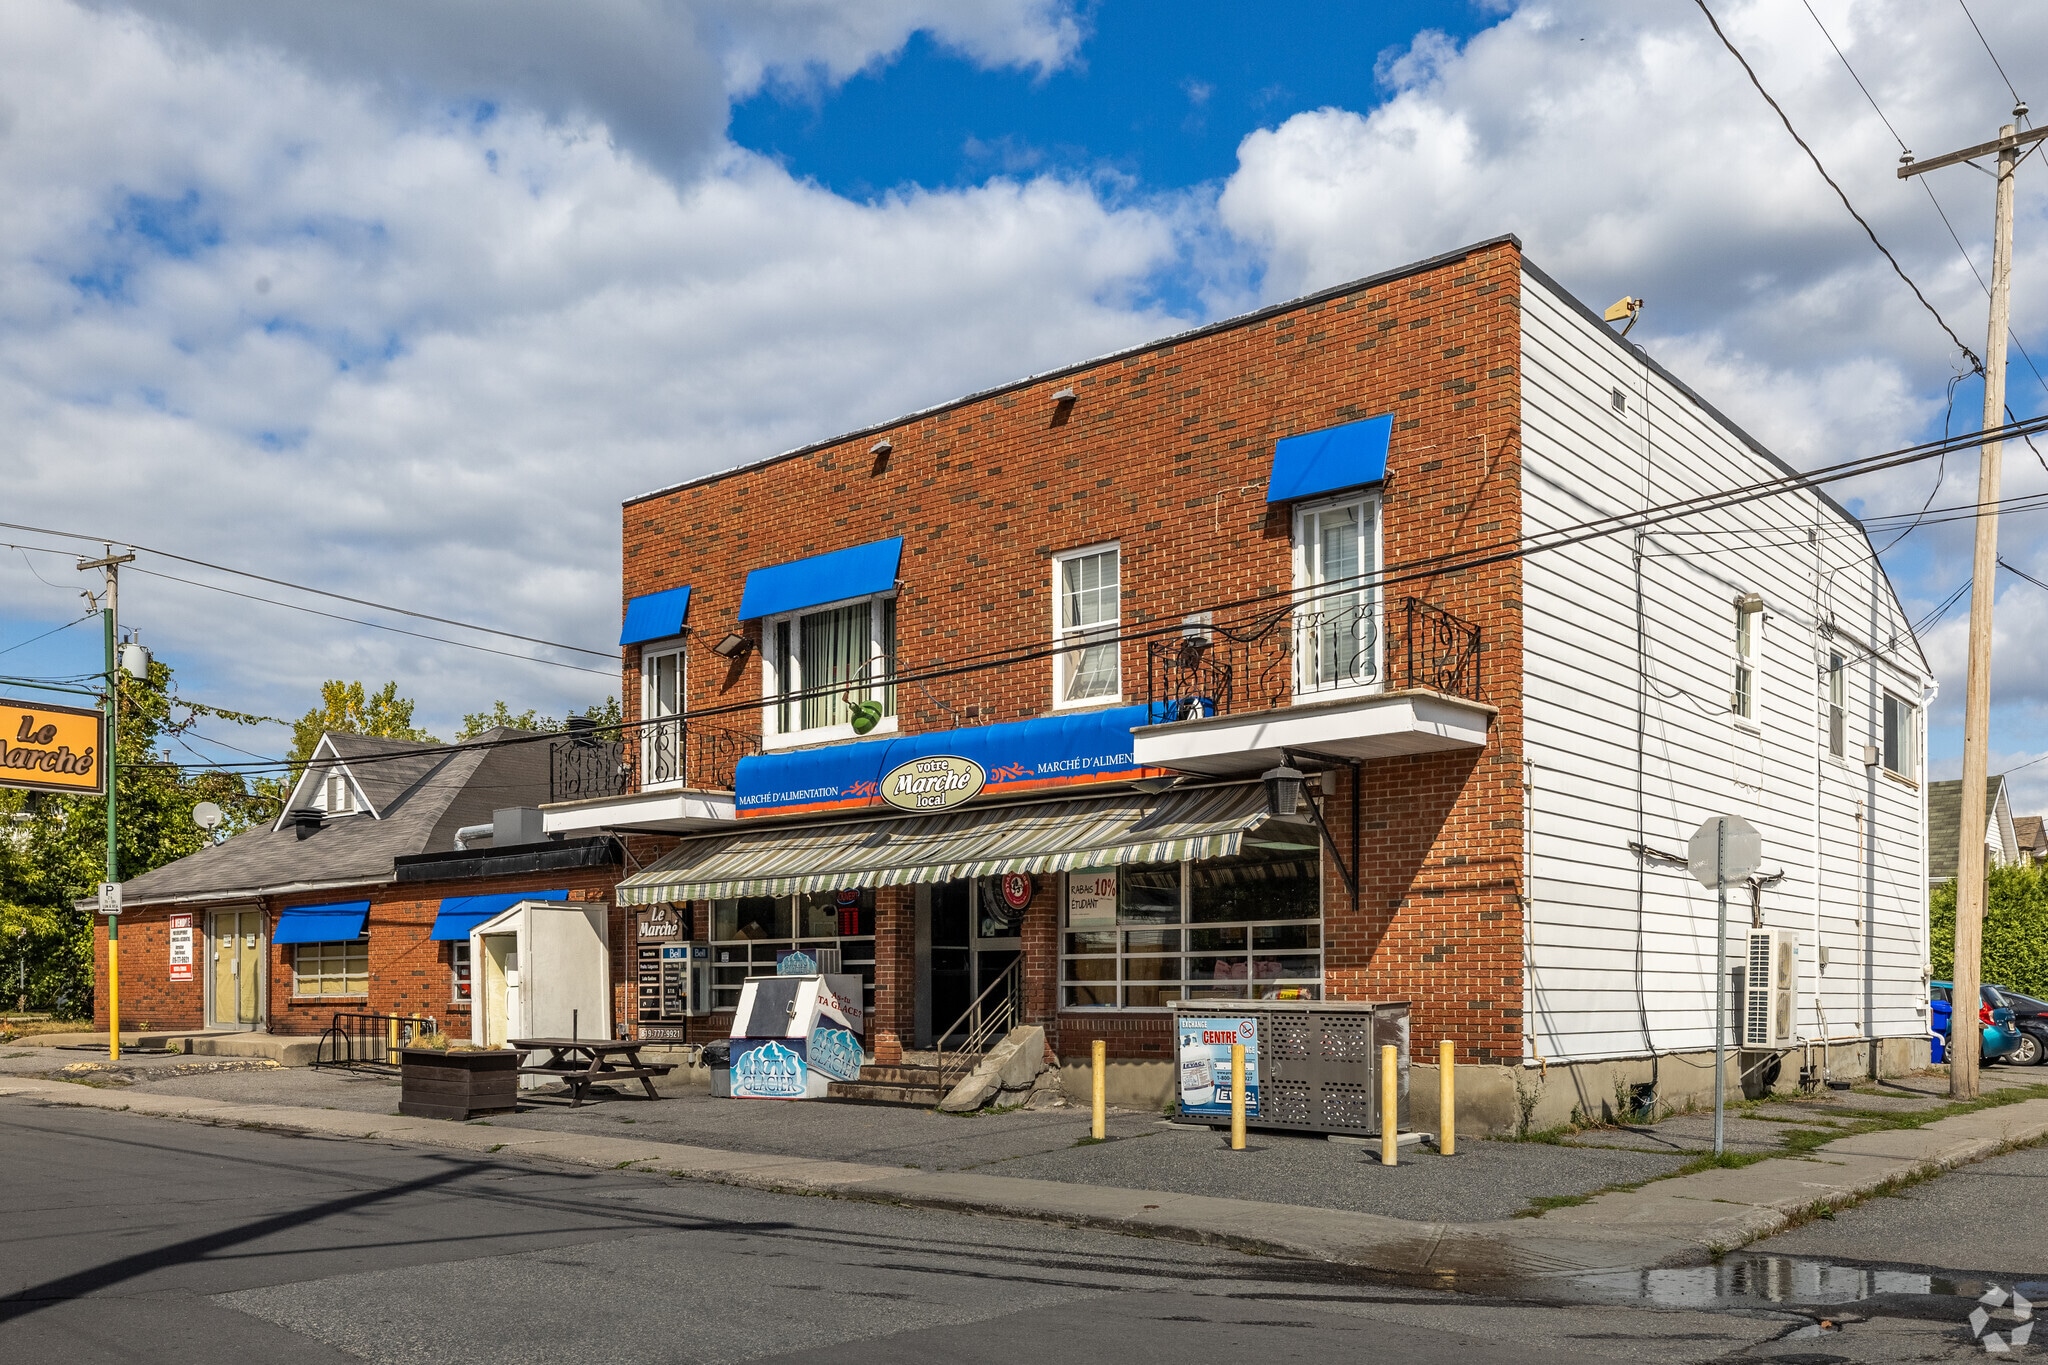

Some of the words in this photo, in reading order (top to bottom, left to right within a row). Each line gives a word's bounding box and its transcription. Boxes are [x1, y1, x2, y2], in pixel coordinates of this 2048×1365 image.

[17, 715, 57, 745] Le
[916, 760, 949, 773] votre
[1037, 756, 1081, 774] MARCHÉ
[1082, 752, 1134, 769] D'ALIMEN
[893, 765, 971, 796] Marché
[739, 791, 772, 805] MARCHÉ
[772, 786, 839, 802] D'ALIMENTATION
[916, 792, 946, 808] local
[105, 885, 115, 896] P
[1071, 885, 1094, 894] RABAIS
[1094, 878, 1116, 896] 10%
[1071, 898, 1099, 910] ÉTUDIANT
[651, 906, 665, 922] Le
[639, 919, 678, 937] Marché
[670, 948, 682, 958] Bell
[694, 948, 706, 957] Bell
[831, 991, 851, 1004] As-tu
[818, 996, 829, 1007] TA
[831, 1000, 862, 1017] GLACE?
[1182, 1021, 1208, 1029] EXCHANGE
[640, 1029, 681, 1038] 819-777-9921
[1203, 1030, 1237, 1045] CENTRE
[811, 1030, 863, 1068] ARCTIC
[743, 1055, 797, 1076] ARCTIC
[810, 1046, 861, 1081] GLACIER
[743, 1076, 797, 1092] GLACIER
